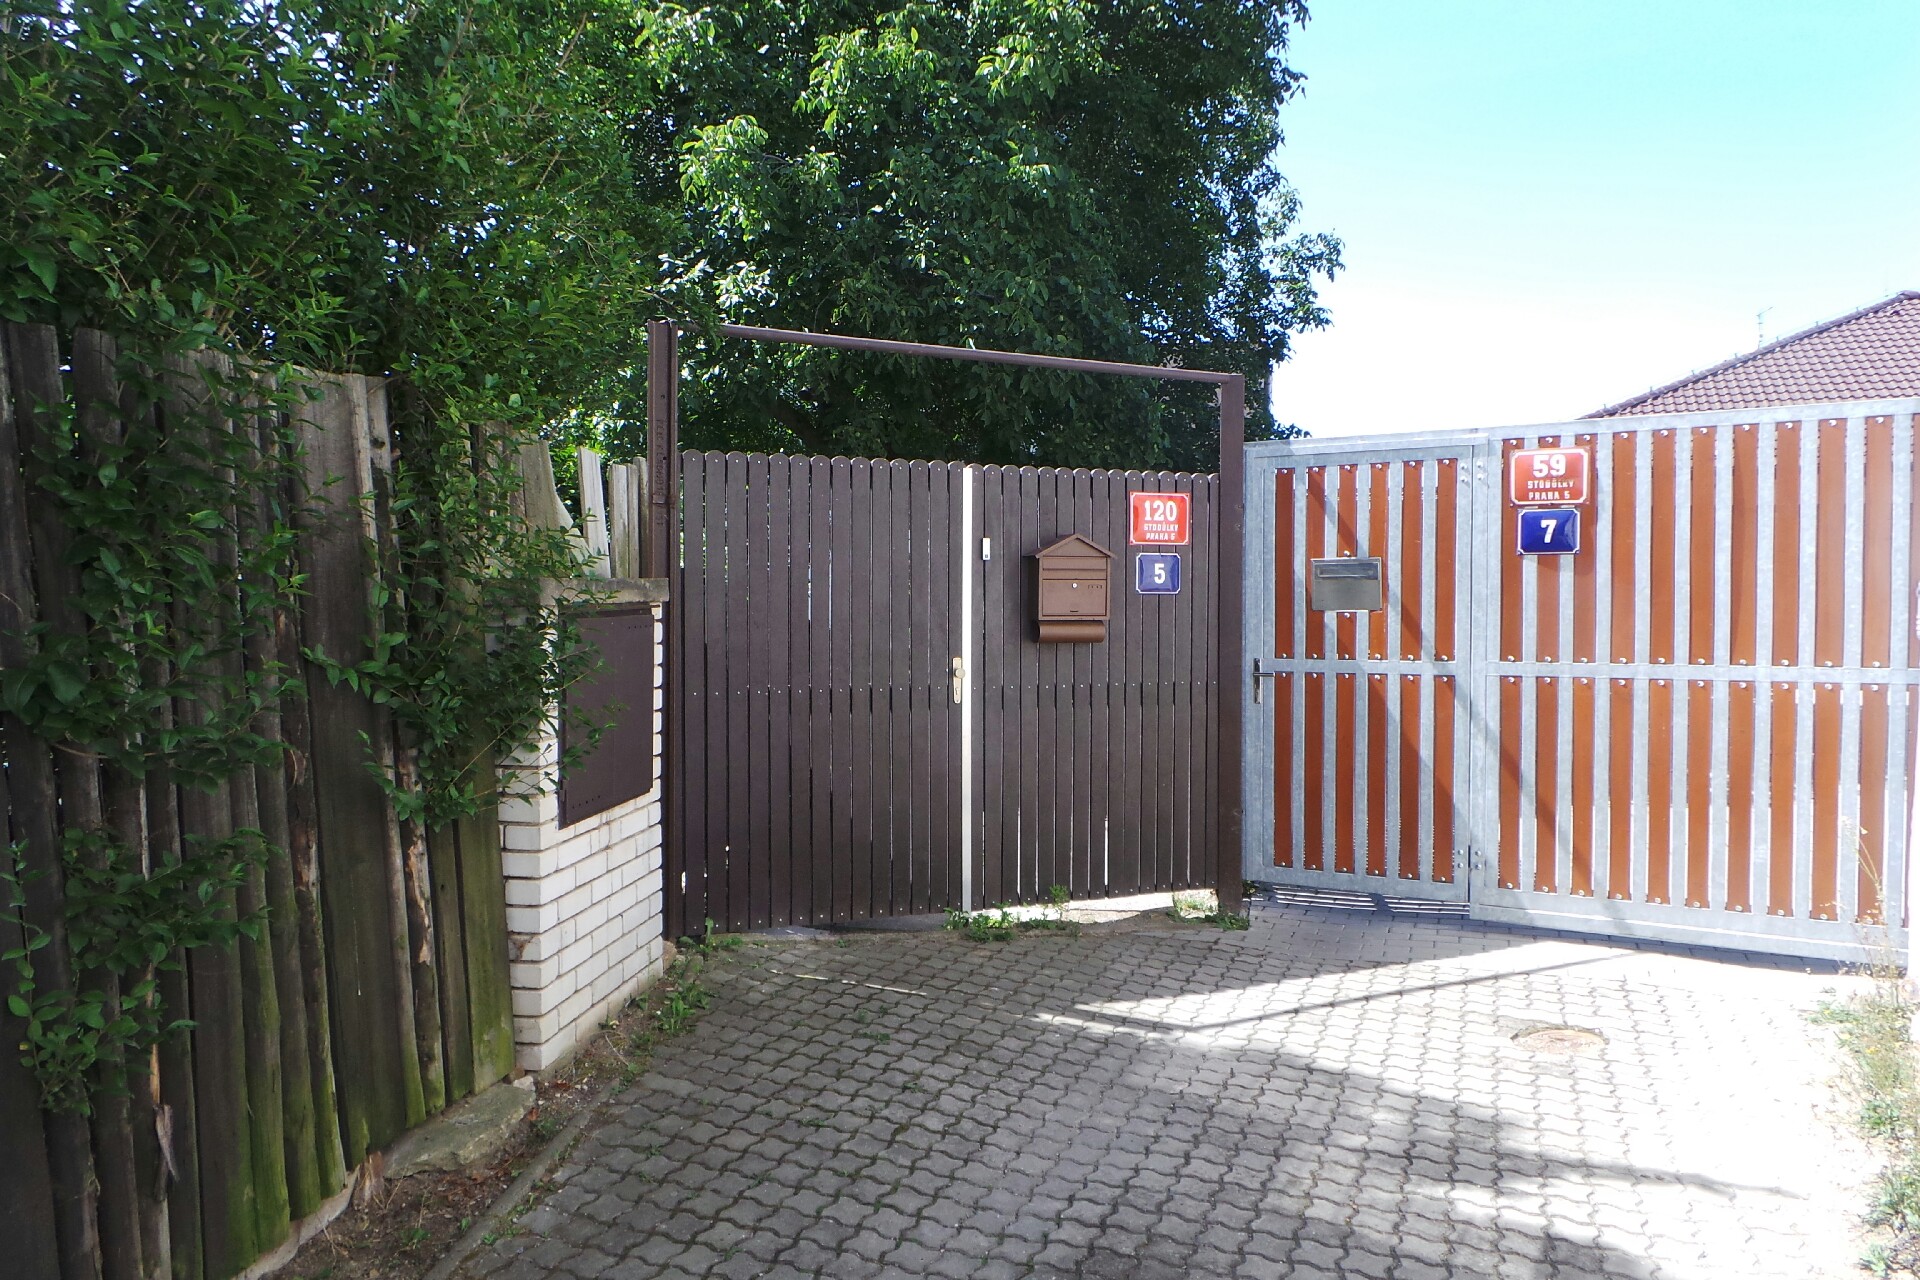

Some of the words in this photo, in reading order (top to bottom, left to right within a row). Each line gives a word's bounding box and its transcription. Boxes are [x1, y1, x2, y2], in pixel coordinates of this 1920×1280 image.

[1532, 454, 1566, 477] 59
[1528, 491, 1560, 500] PRAHA
[1564, 490, 1571, 499] 5
[1144, 500, 1177, 521] 120
[1146, 532, 1169, 541] PRAHA
[1540, 519, 1557, 543] 7
[1154, 563, 1166, 584] 5
